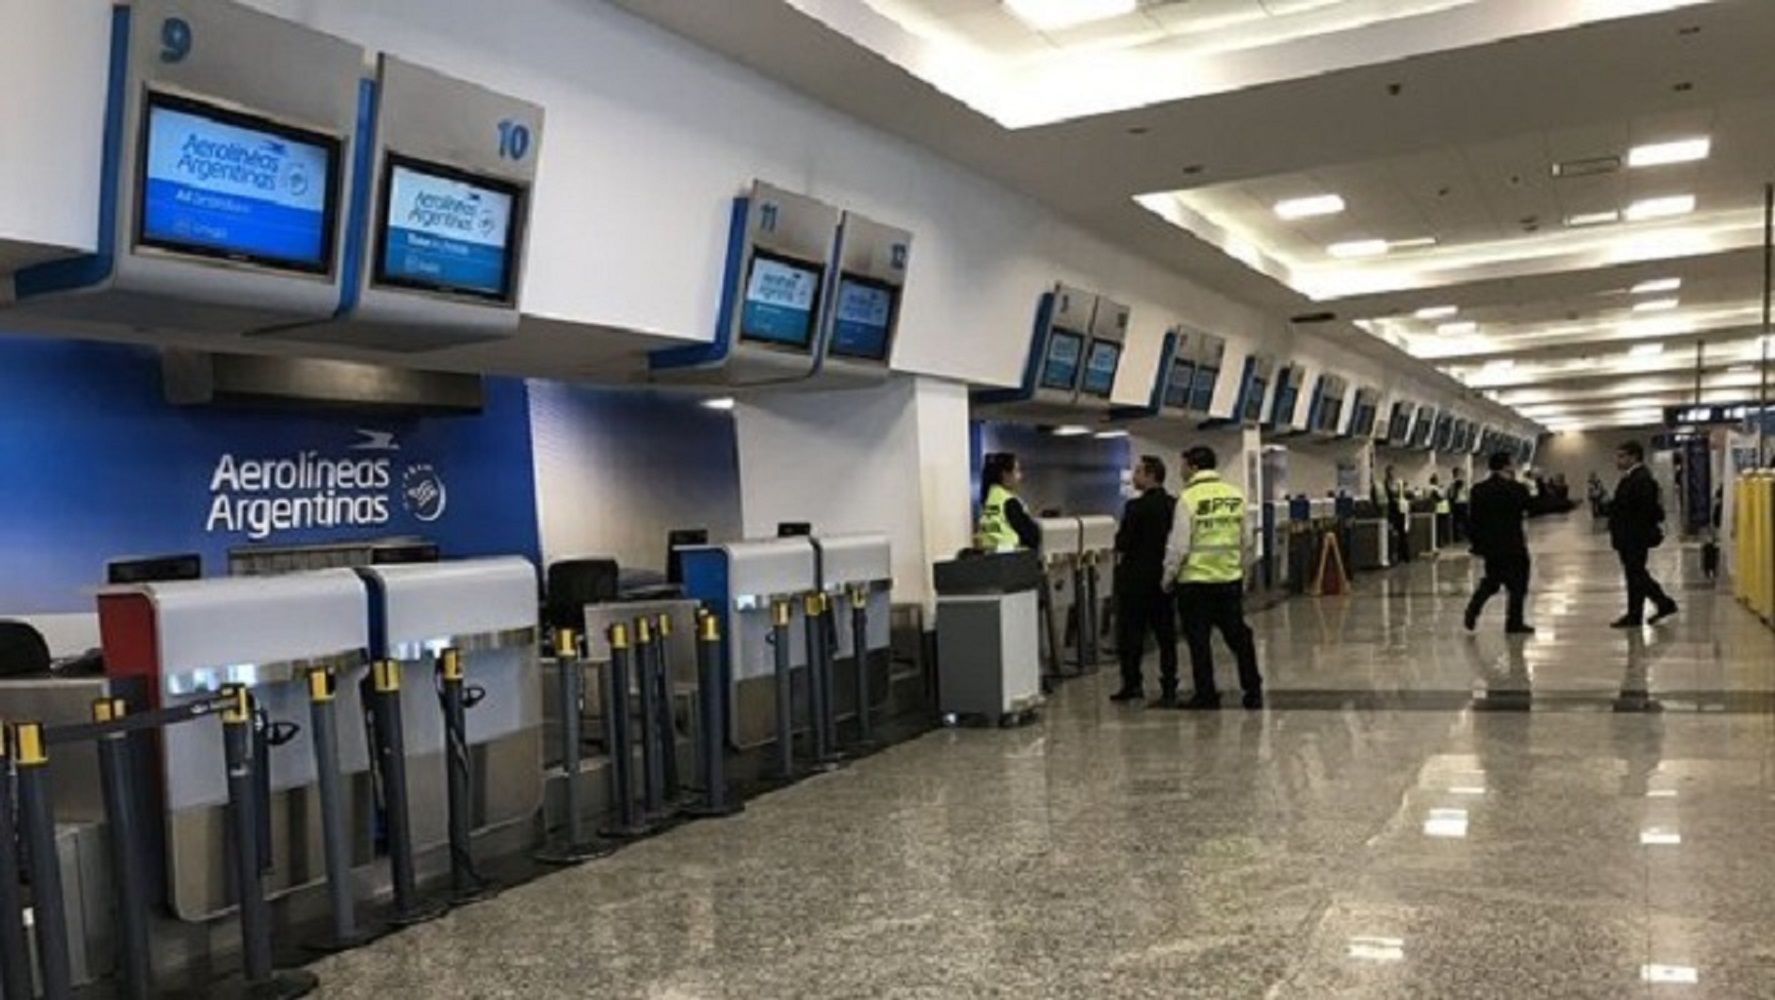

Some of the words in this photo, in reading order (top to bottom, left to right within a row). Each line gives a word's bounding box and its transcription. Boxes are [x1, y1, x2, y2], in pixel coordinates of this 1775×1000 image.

[160, 17, 192, 64] 9
[497, 119, 530, 160] 10
[176, 155, 277, 191] Argentinas
[760, 202, 778, 232] 11
[209, 451, 390, 491] Aerolíneas
[206, 490, 389, 539] Argentinas
